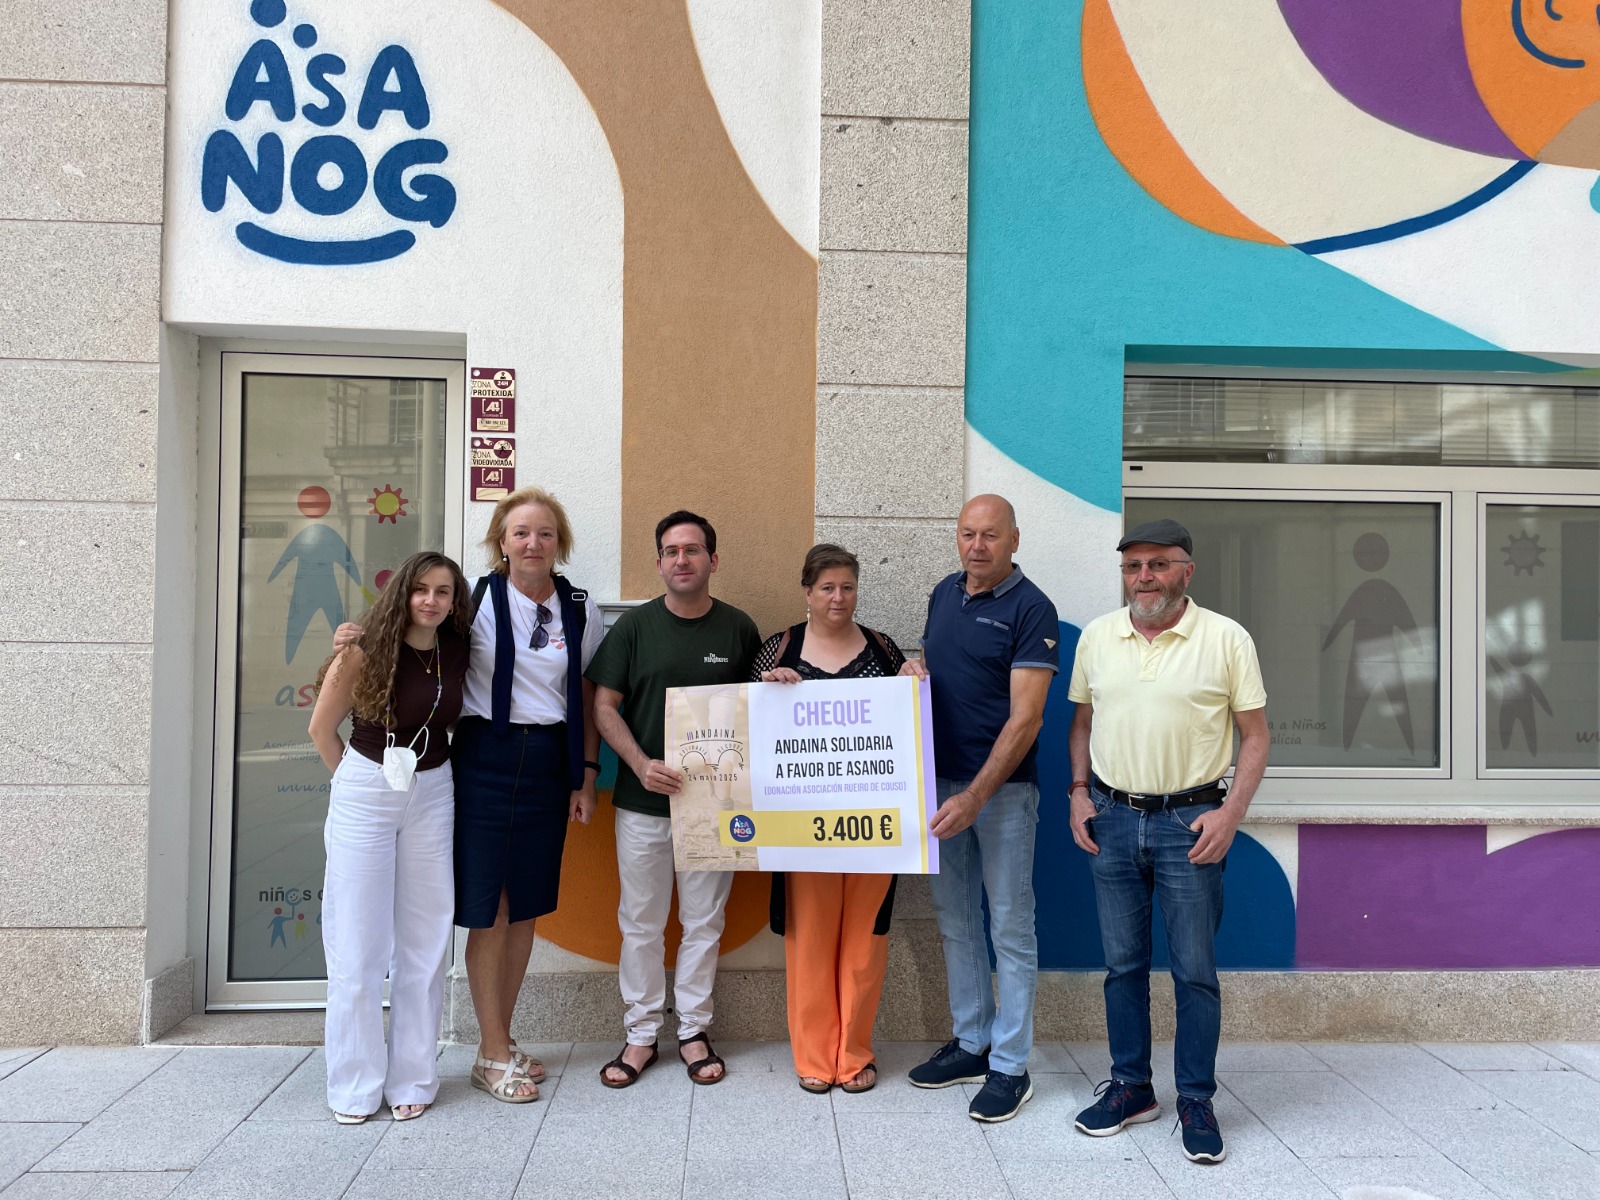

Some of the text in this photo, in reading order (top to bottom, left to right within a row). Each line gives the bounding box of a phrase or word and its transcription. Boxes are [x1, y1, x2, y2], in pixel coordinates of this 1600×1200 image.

[201, 129, 457, 228] NOG
[472, 389, 513, 397] PROTEXIDA
[793, 699, 872, 727] CHEQUE
[1292, 718, 1327, 730] Niños
[695, 728, 735, 739] ANDAINA
[1270, 733, 1302, 745] alicia
[775, 735, 894, 754] ANDAINA SOLIDARIA
[775, 759, 895, 779] A FAVOR DE ASANOG
[688, 774, 697, 782] 24
[719, 773, 738, 782] 2025
[802, 782, 843, 794] ASOCIACIÓN
[844, 782, 869, 793] RUEIRO
[870, 782, 880, 792] DE
[880, 780, 907, 792] COUSO)
[733, 827, 753, 835] NOG
[812, 814, 893, 842] 3.400 €
